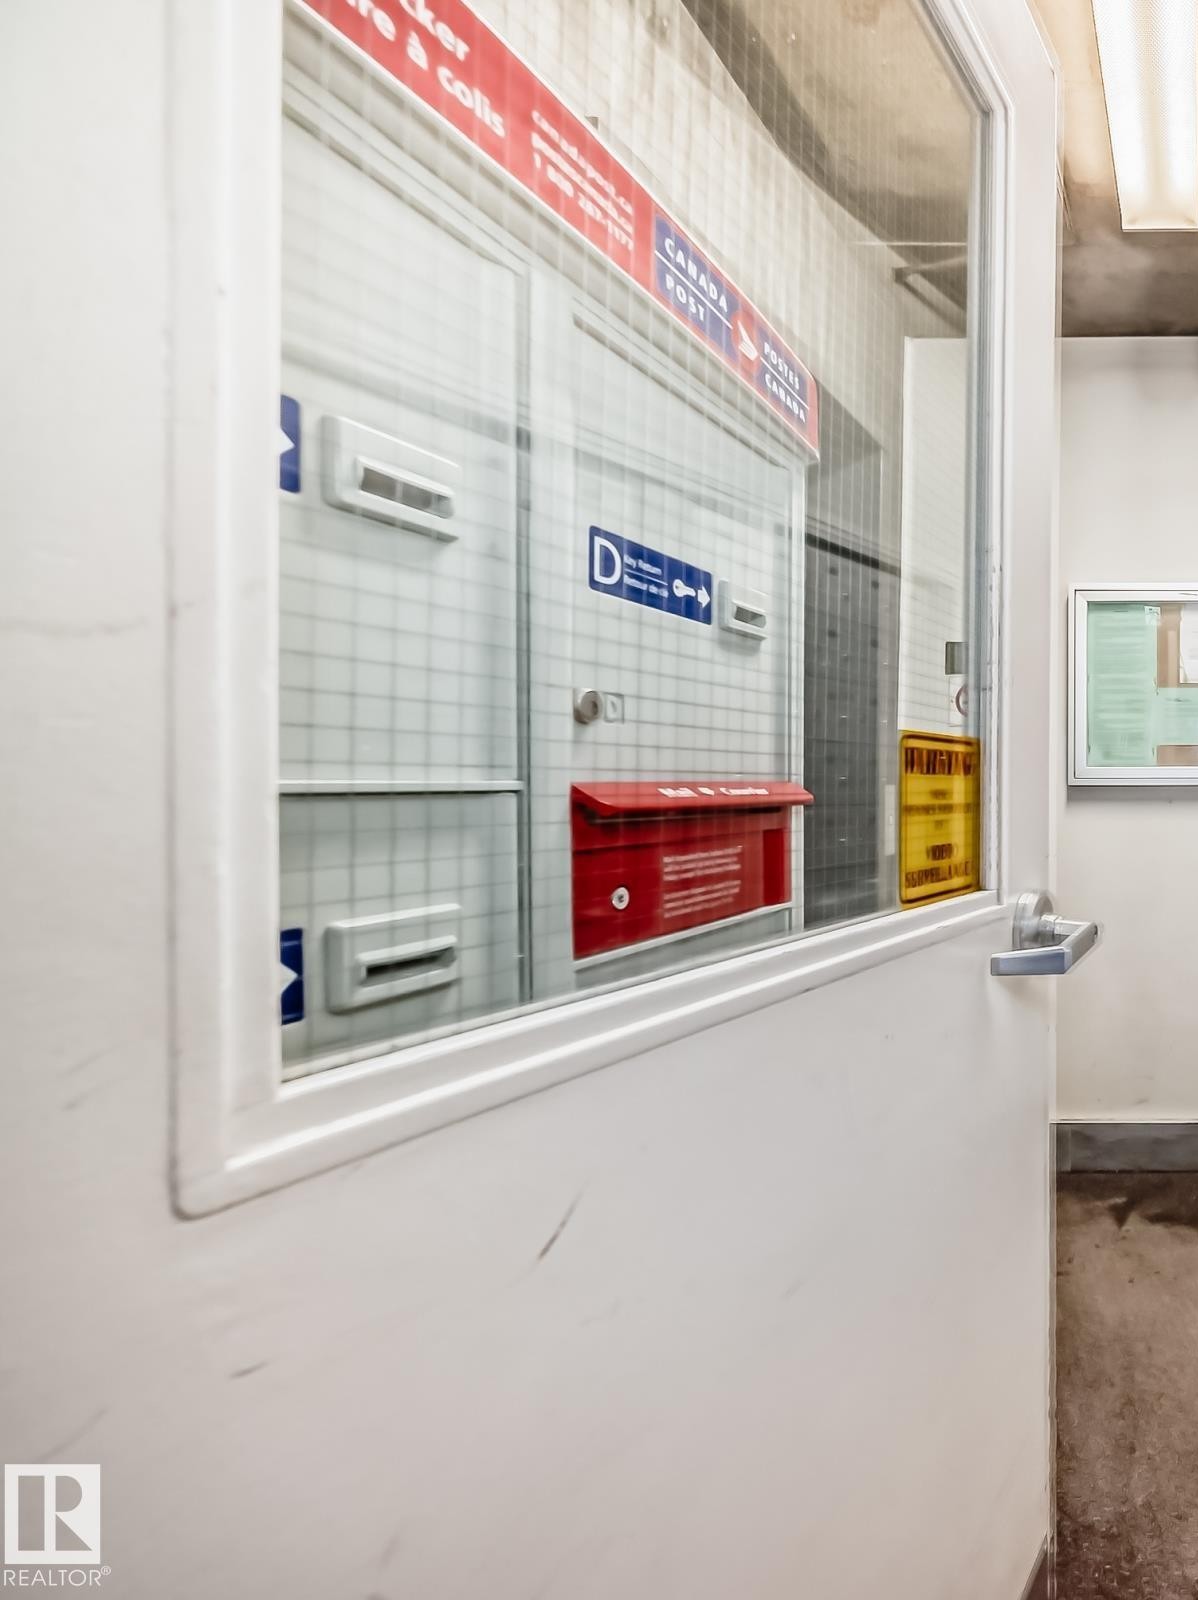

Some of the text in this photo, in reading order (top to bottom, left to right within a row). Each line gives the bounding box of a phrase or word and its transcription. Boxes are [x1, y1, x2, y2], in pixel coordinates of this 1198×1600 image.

[664, 237, 729, 314] CANADA
[665, 273, 706, 322] POST
[763, 341, 801, 391] POSTES
[764, 373, 806, 424] CANADA
[593, 535, 621, 585] D
